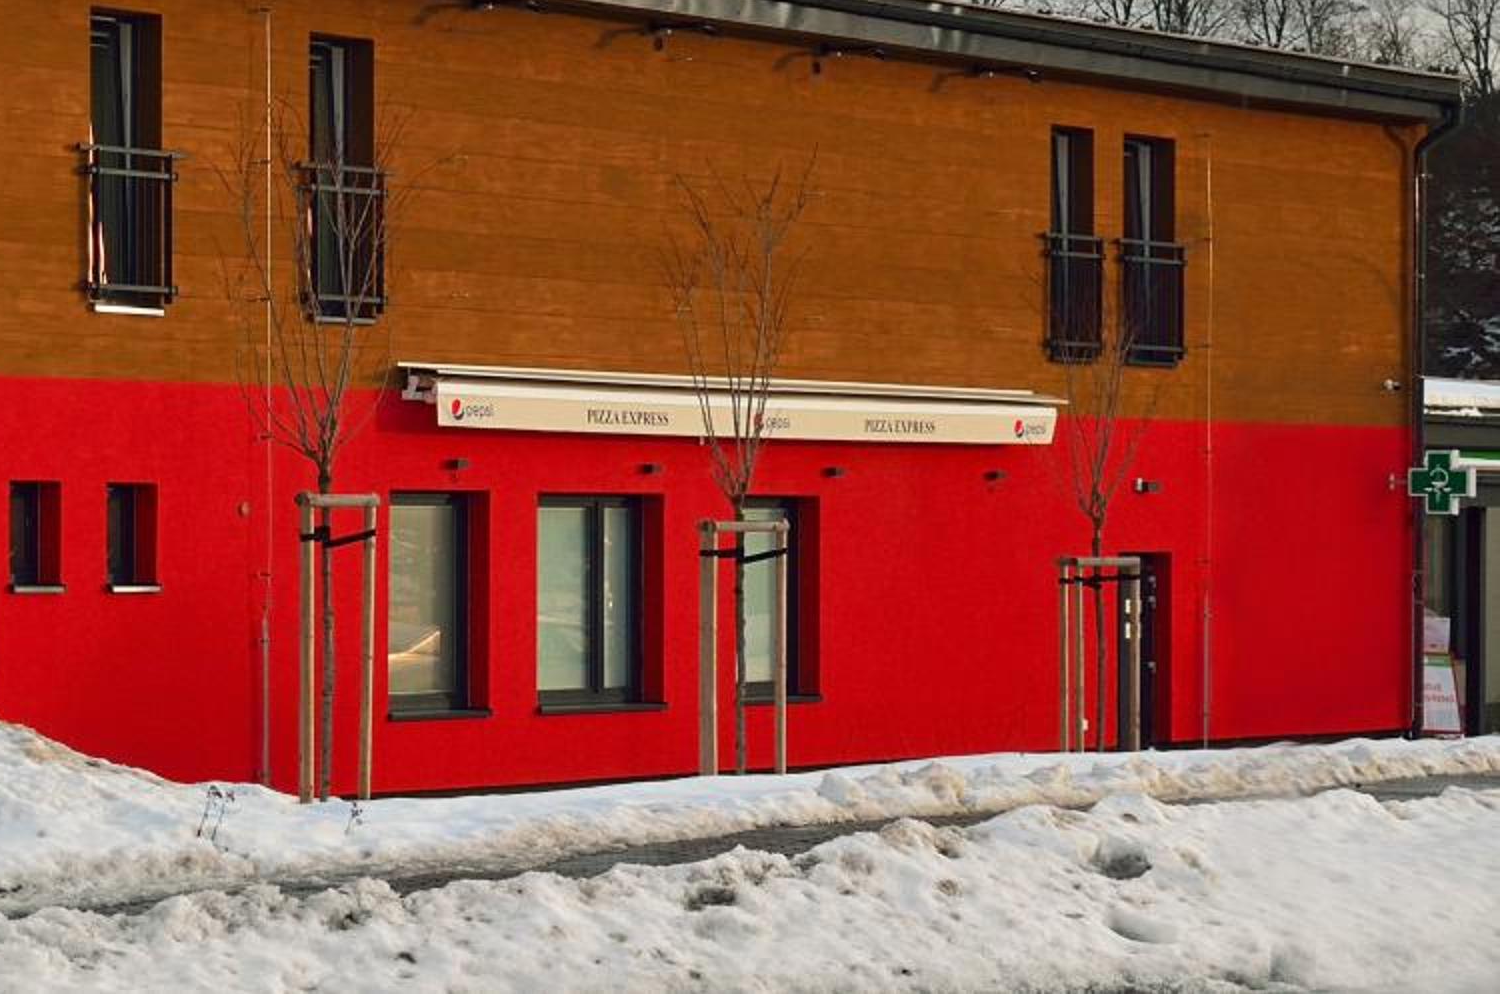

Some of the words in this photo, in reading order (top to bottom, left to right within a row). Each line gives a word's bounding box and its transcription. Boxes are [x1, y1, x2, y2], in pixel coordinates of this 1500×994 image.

[587, 409, 619, 425] PIZZA
[621, 411, 669, 427] EXPRESS
[864, 418, 893, 434] PIZZA
